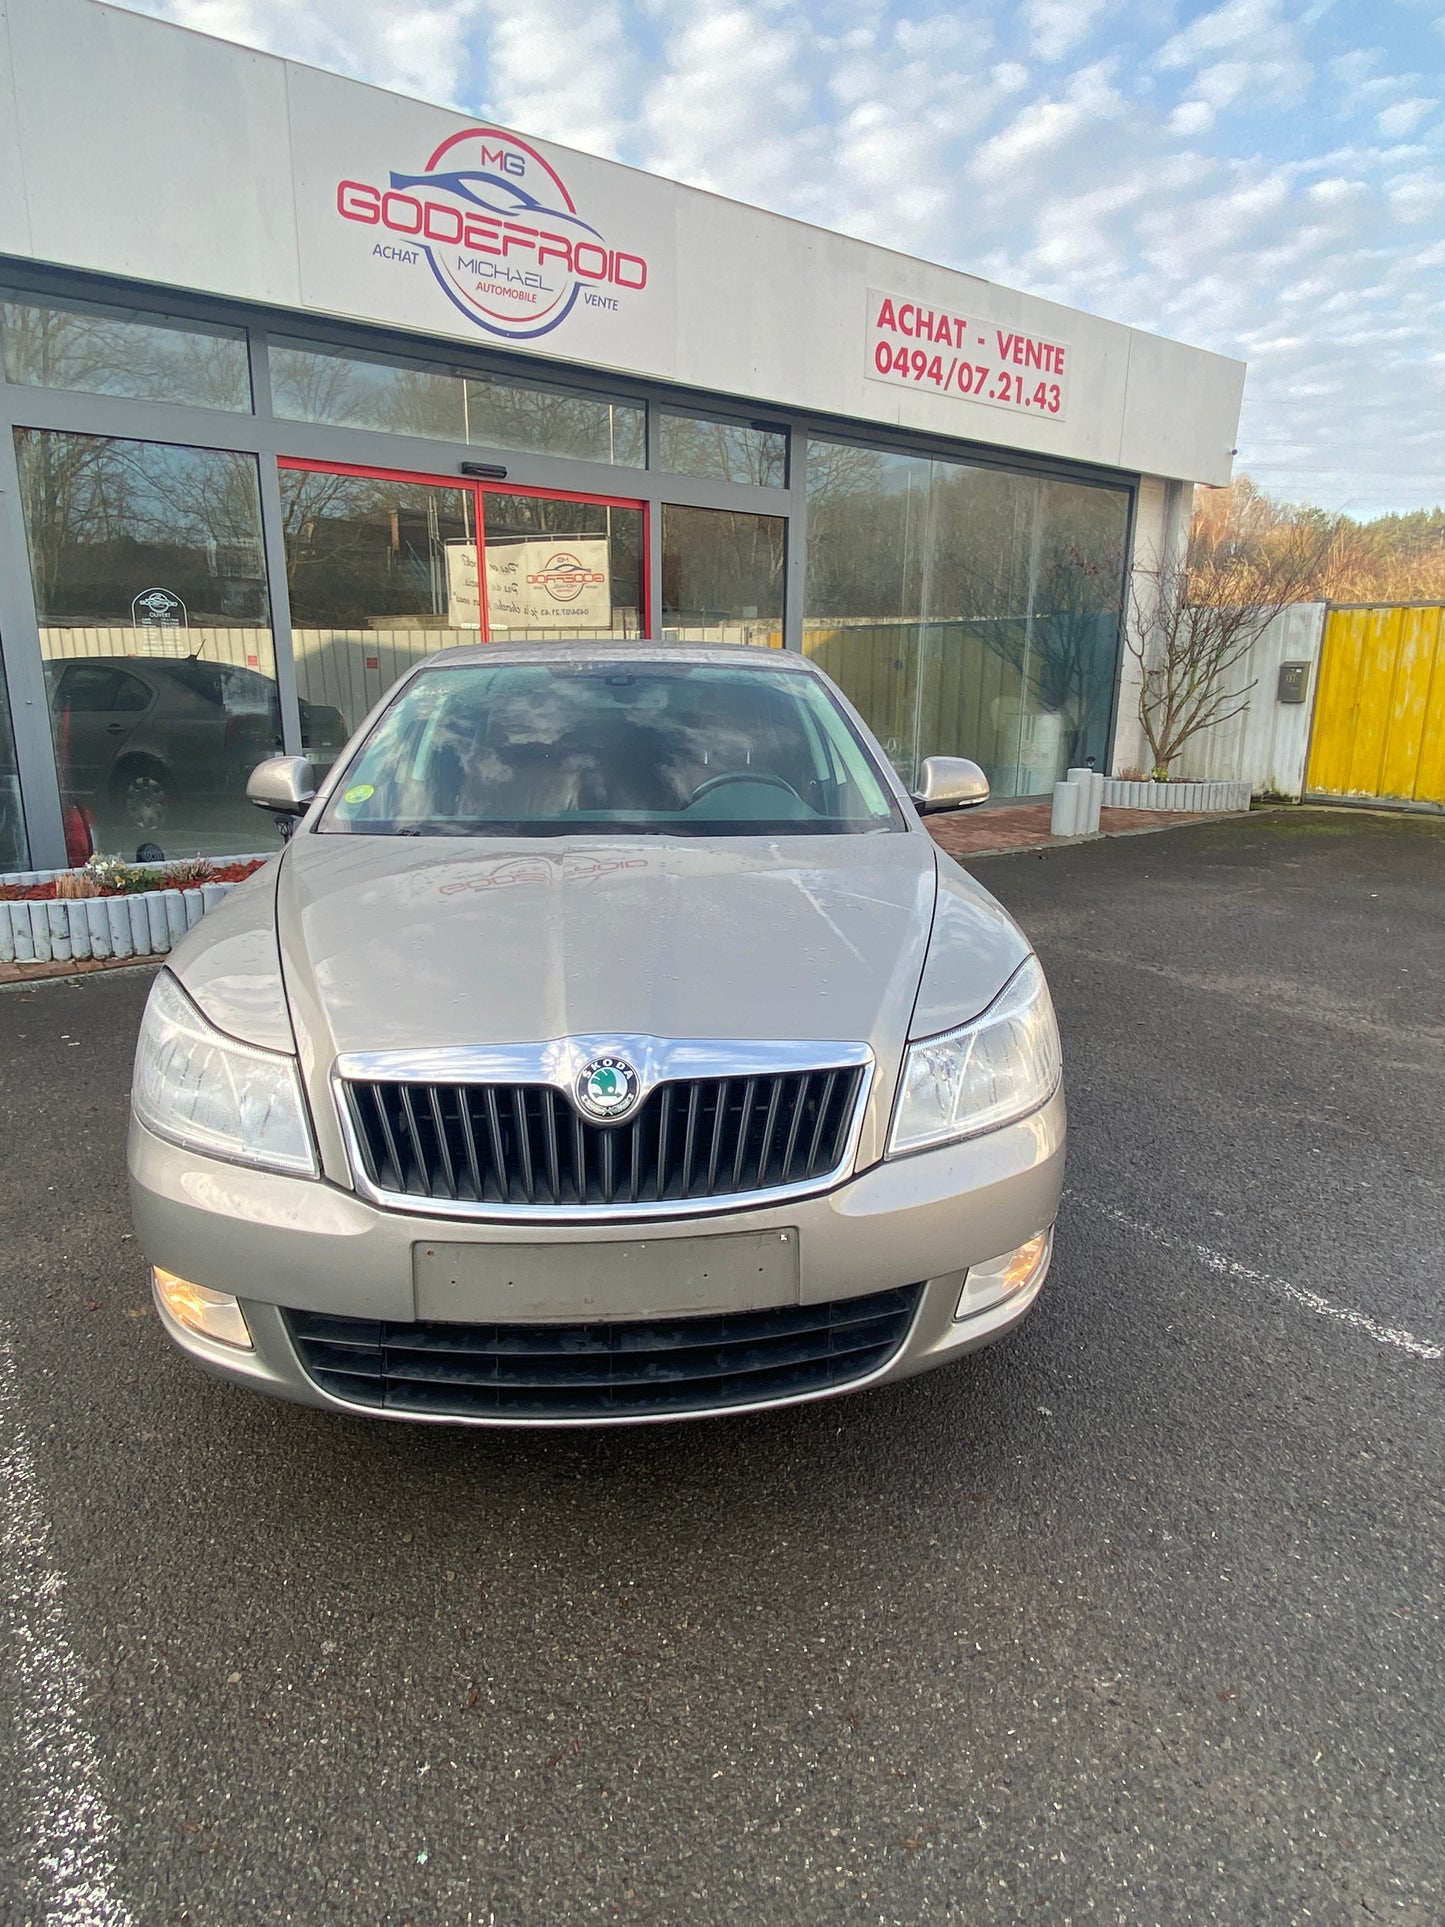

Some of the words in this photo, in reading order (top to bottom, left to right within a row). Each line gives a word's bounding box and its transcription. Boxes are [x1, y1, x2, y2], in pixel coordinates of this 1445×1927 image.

[481, 144, 526, 177] MG
[336, 179, 648, 291] GODEFROID
[372, 243, 419, 265] ACHAT
[457, 255, 554, 293] MICHAEL
[475, 281, 538, 304] AUTOMOBILE
[584, 292, 619, 312] VENTE
[876, 297, 967, 349] ACHAT
[996, 329, 1066, 375] VENTE
[874, 341, 1061, 413] 0494/07.21.43
